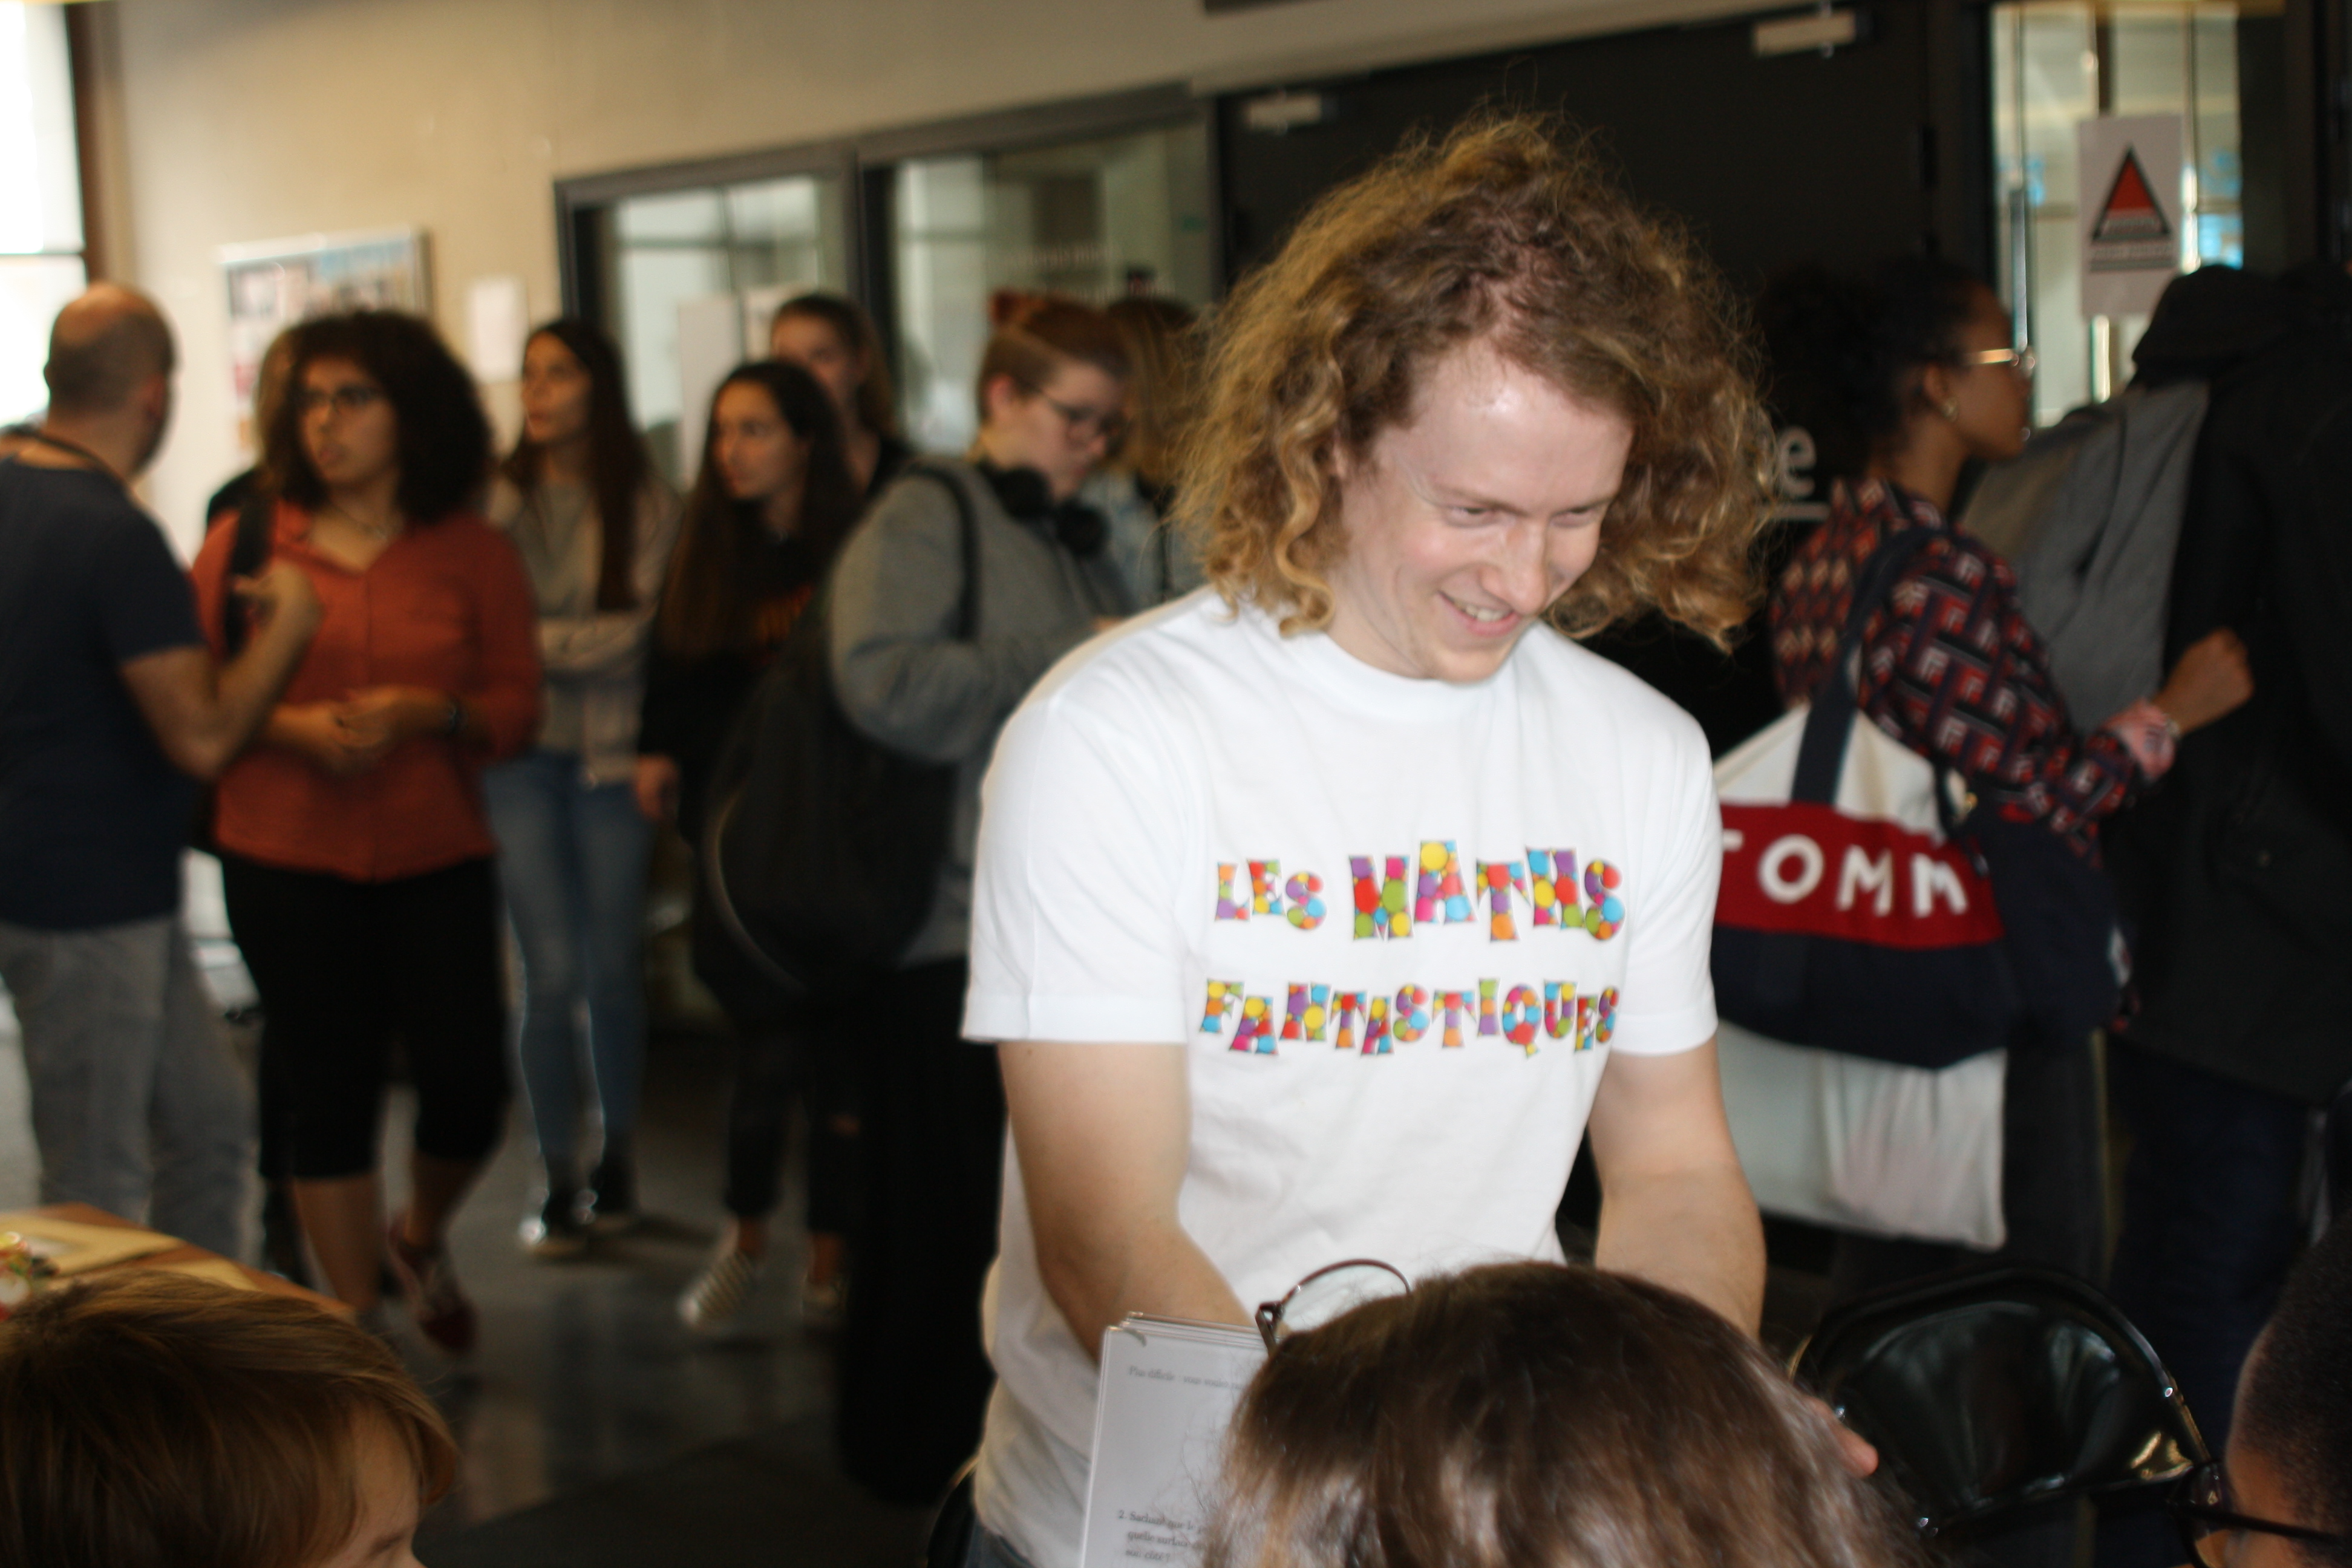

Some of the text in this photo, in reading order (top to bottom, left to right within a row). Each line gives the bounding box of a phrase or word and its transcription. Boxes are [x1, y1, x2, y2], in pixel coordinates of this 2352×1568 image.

[1214, 839, 1626, 942] LES MATHS
[1199, 977, 1621, 1059] FANTASTIQUES
